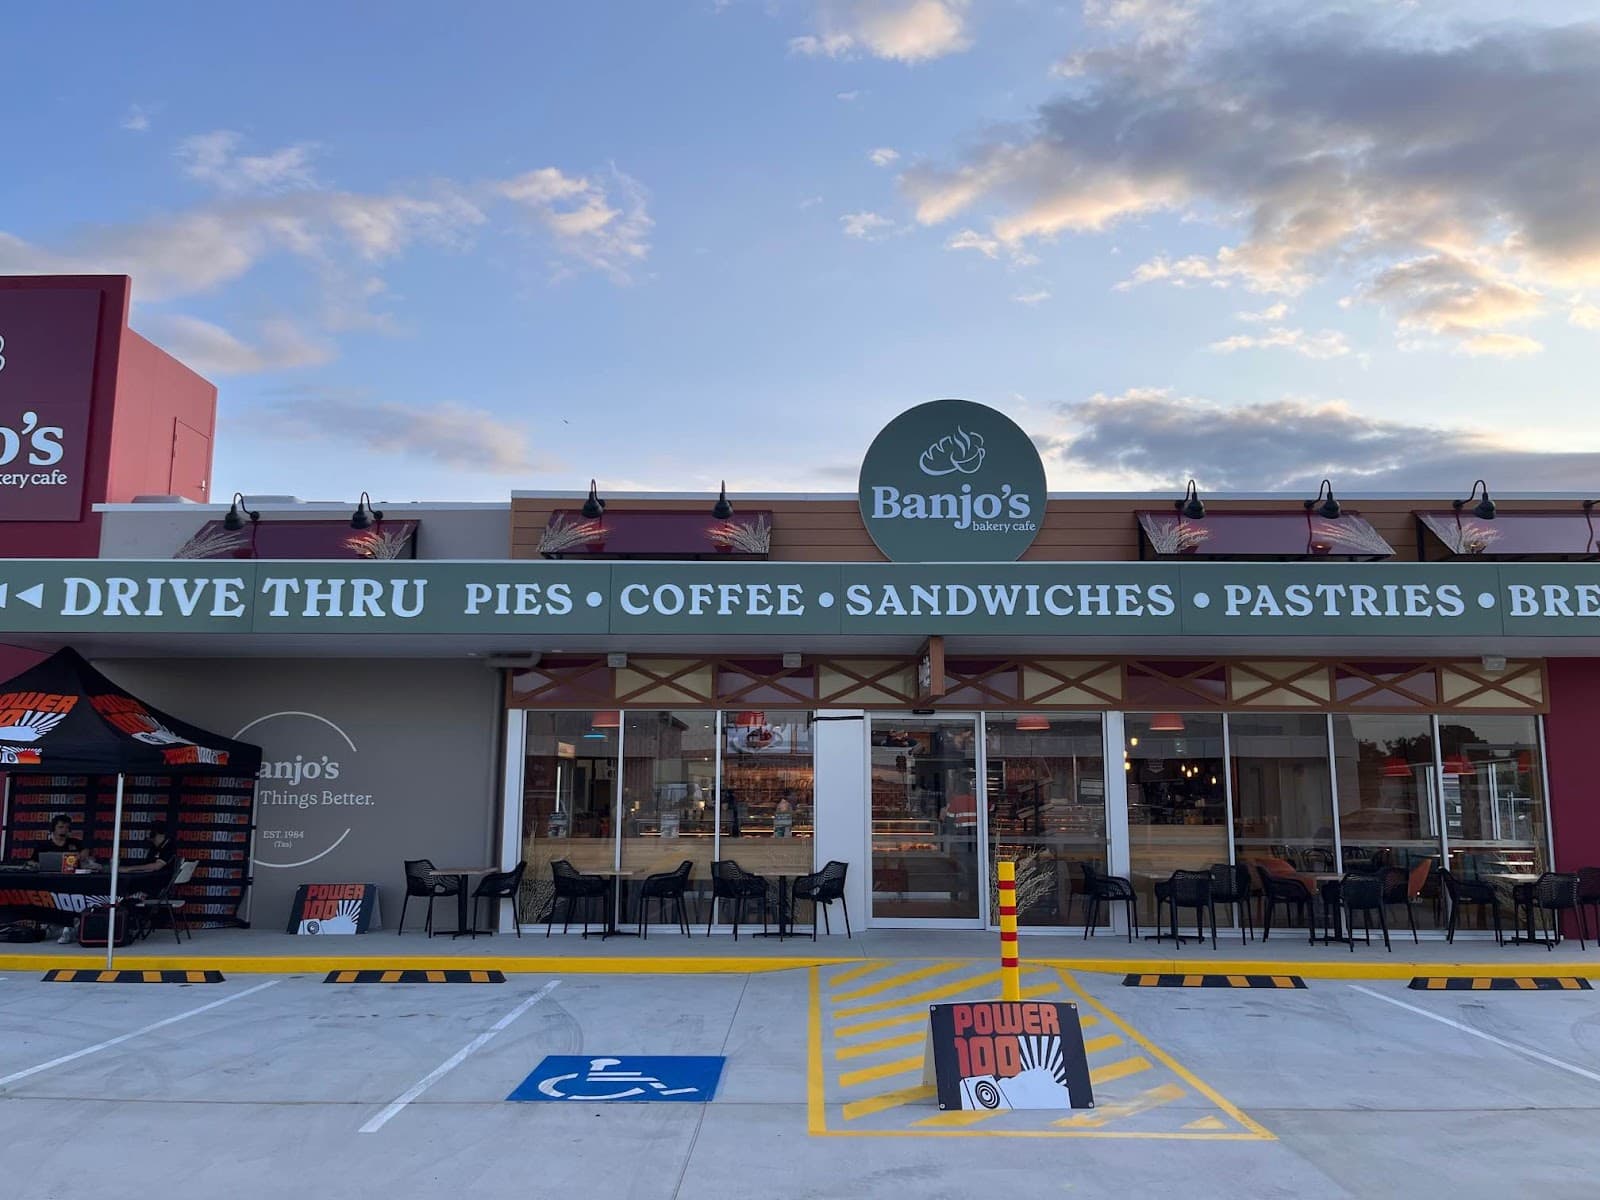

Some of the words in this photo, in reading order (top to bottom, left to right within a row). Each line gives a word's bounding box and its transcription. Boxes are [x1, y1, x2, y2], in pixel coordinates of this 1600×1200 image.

[31, 469, 68, 485] cafe
[871, 483, 1031, 529] Banjo's
[972, 520, 1011, 533] bakery
[1012, 520, 1036, 531] cafe
[60, 577, 246, 618] DRIVE
[261, 577, 428, 618] THRU
[464, 582, 574, 616] PIES
[619, 583, 806, 617] COFFEE
[845, 583, 1176, 617] SANDWICHES
[1223, 583, 1466, 618] PASTRIES
[260, 754, 340, 786] anjo's
[260, 790, 318, 808] Things
[321, 790, 375, 806] Better.
[307, 885, 366, 900] POWER
[302, 901, 339, 920] 100
[952, 1003, 1062, 1036] POWER
[954, 1035, 1023, 1078] 100
